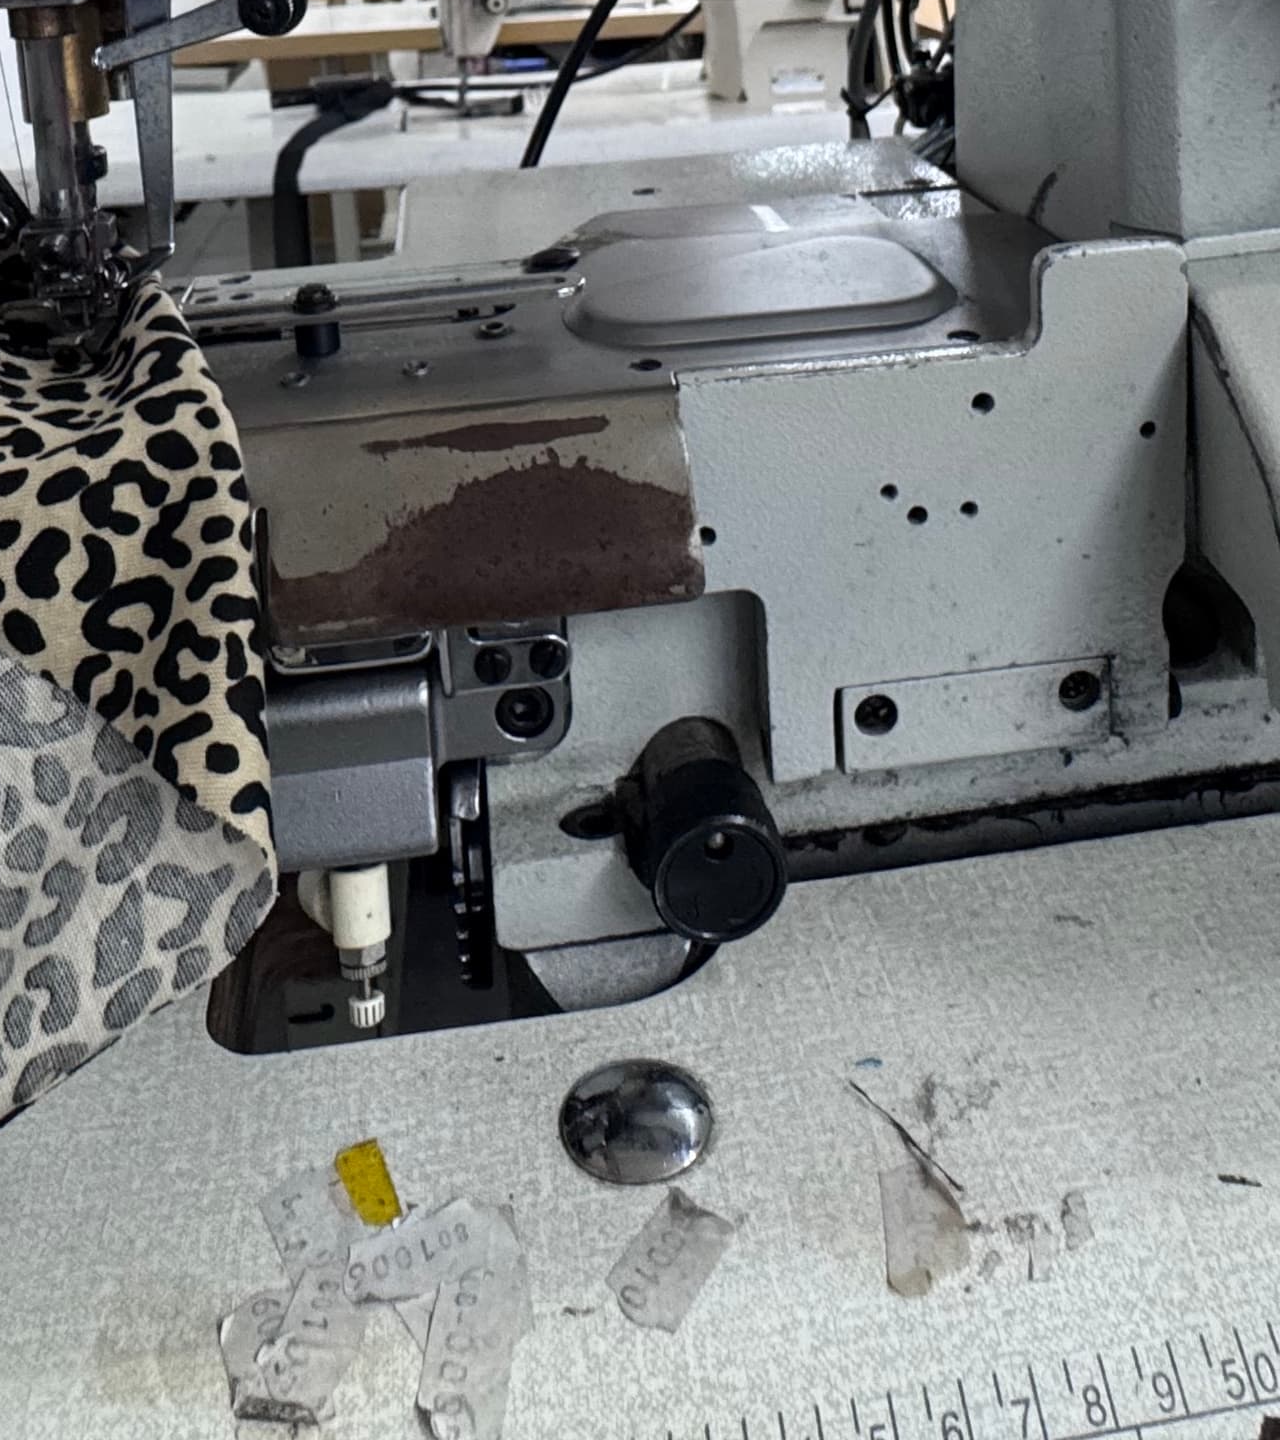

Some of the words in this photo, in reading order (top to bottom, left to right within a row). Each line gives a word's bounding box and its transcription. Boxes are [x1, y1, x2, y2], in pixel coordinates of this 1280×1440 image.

[1010, 1398, 1030, 1440] 7
[1082, 1384, 1107, 1427] 8
[1151, 1371, 1176, 1412] 9
[1221, 1352, 1279, 1401] 50
